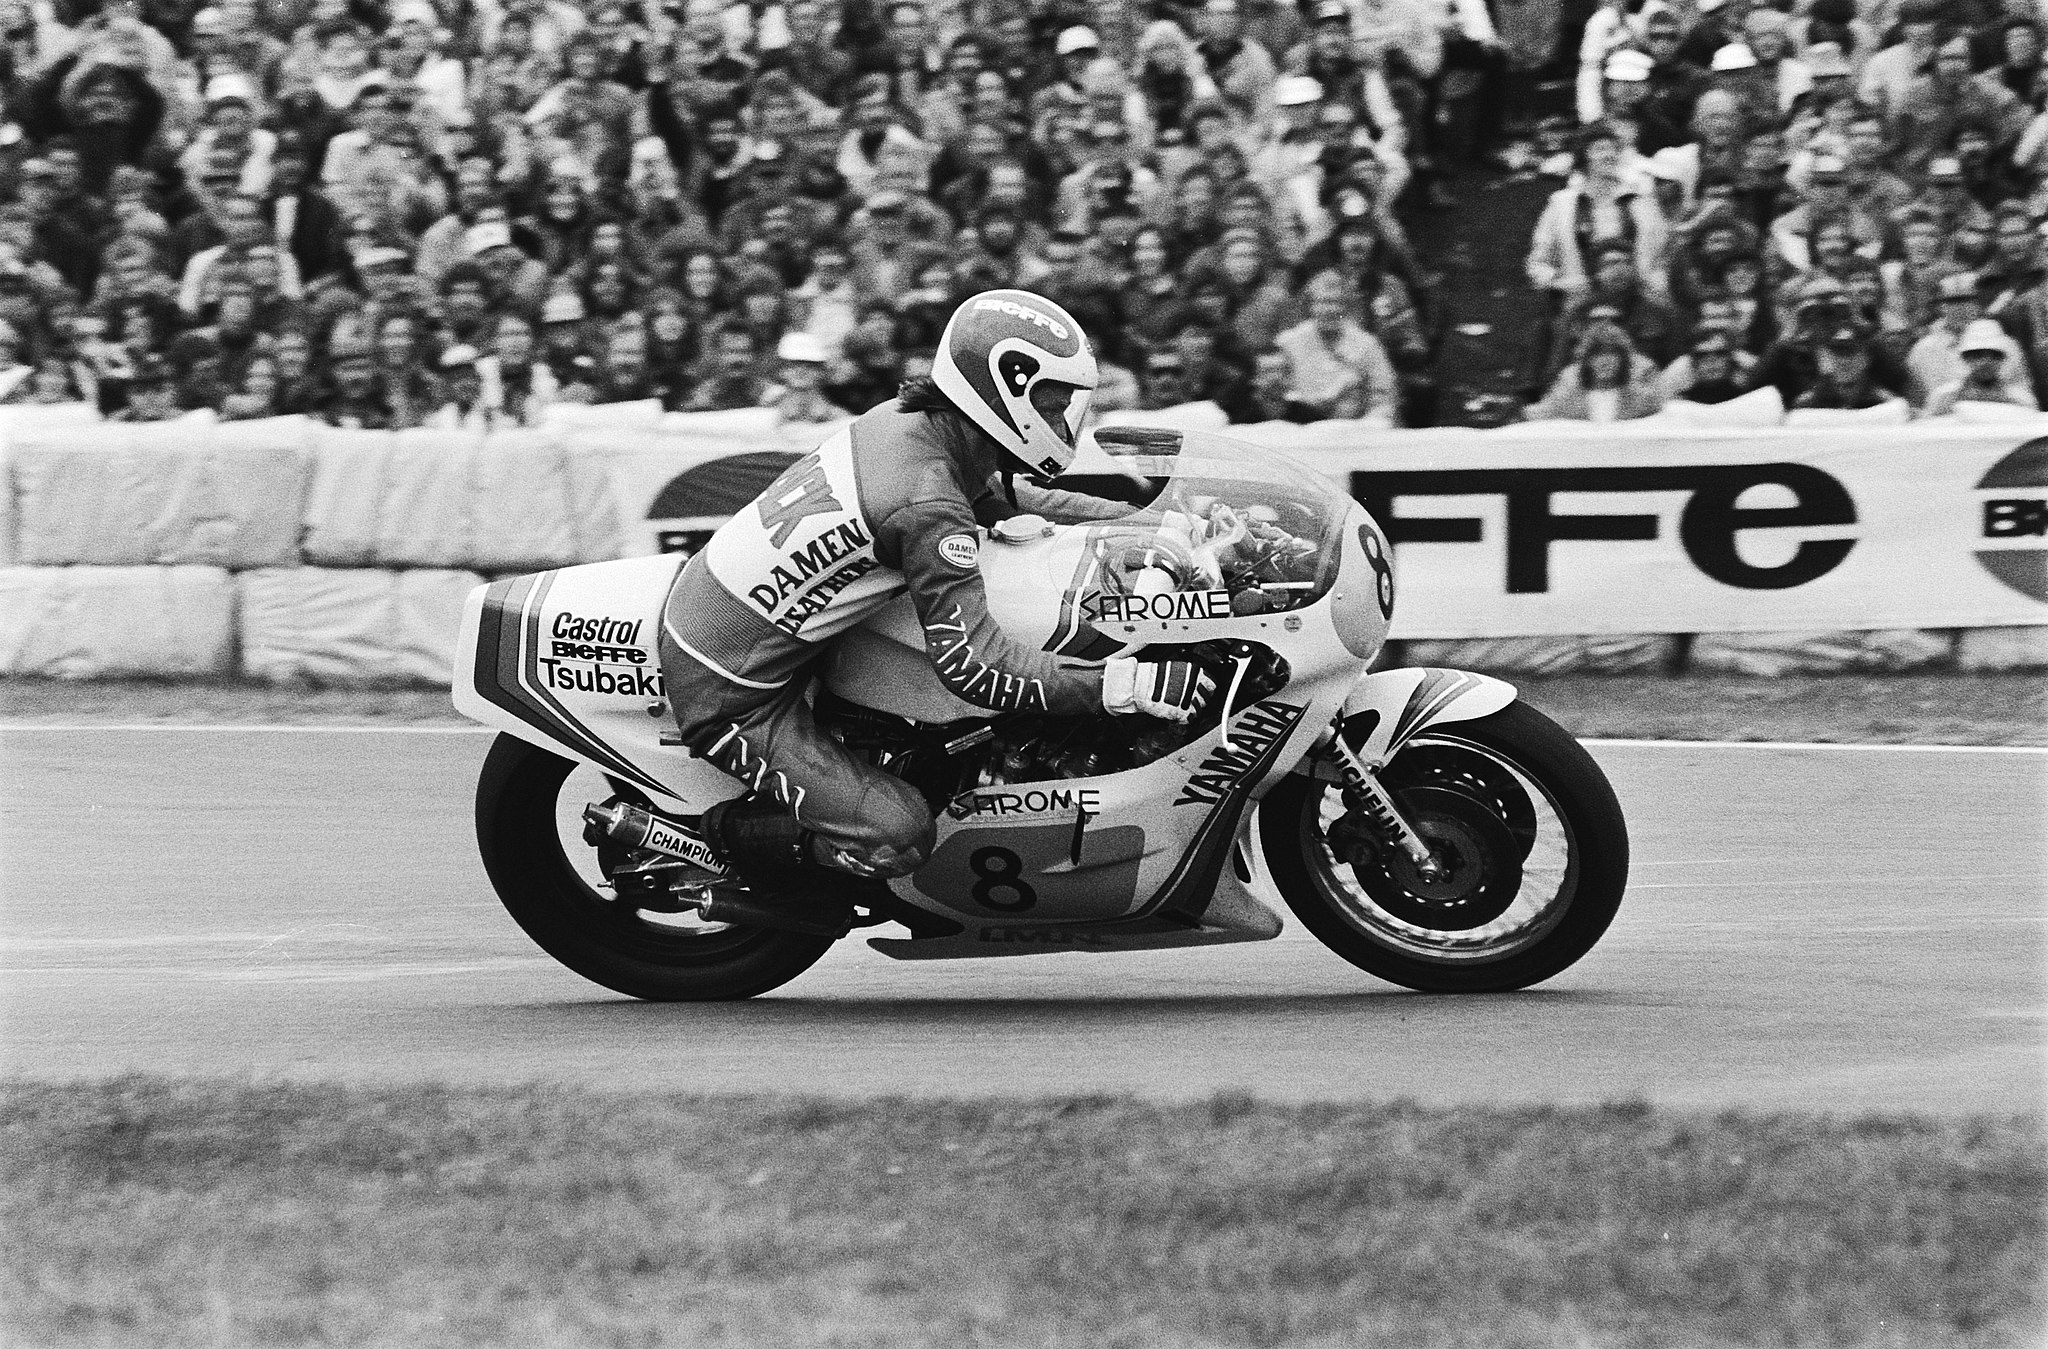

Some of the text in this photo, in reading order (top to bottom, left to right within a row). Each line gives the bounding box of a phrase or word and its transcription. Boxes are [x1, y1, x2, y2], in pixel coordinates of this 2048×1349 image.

[748, 518, 871, 614] DAMEN
[1080, 589, 1230, 622] SAROME
[1358, 524, 1394, 621] 8
[552, 612, 643, 645] Castrol
[925, 603, 1048, 711] YAMAHA
[540, 657, 666, 697] Tsubaki
[1173, 701, 1302, 806] YAMAHA
[969, 846, 1037, 913] 8
